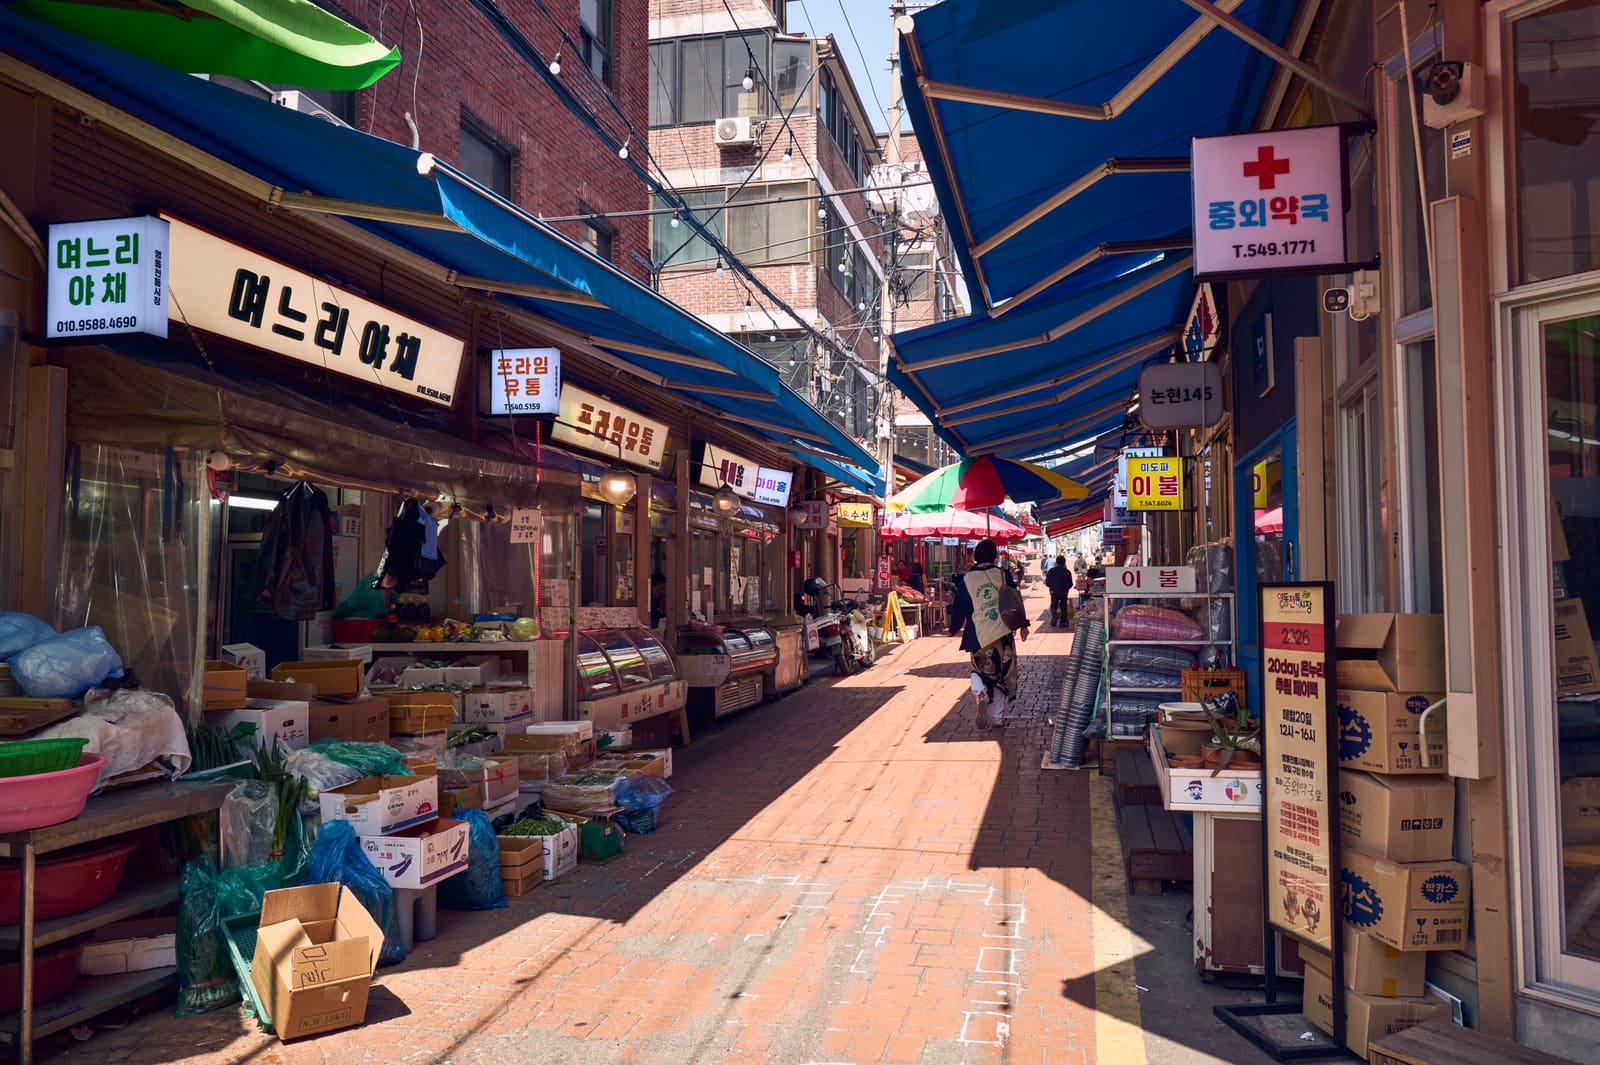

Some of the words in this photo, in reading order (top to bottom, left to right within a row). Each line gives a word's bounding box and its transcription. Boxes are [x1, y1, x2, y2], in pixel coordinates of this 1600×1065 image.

[1208, 193, 1329, 230] 중외약국
[57, 232, 139, 269] 며느리
[1233, 239, 1316, 259] T.549.1771
[69, 271, 127, 306] 야채
[56, 315, 137, 333] 010.9588.4690
[228, 267, 349, 356] 며느리
[358, 319, 422, 381] 야채
[497, 356, 549, 376] 프라임
[504, 377, 541, 397] 유통
[1150, 386, 1213, 405] 논현145
[1140, 462, 1169, 472] 미도파
[1267, 657, 1299, 678] 20day
[1283, 776, 1315, 802] 중외약국
[1425, 882, 1455, 894] 박카스
